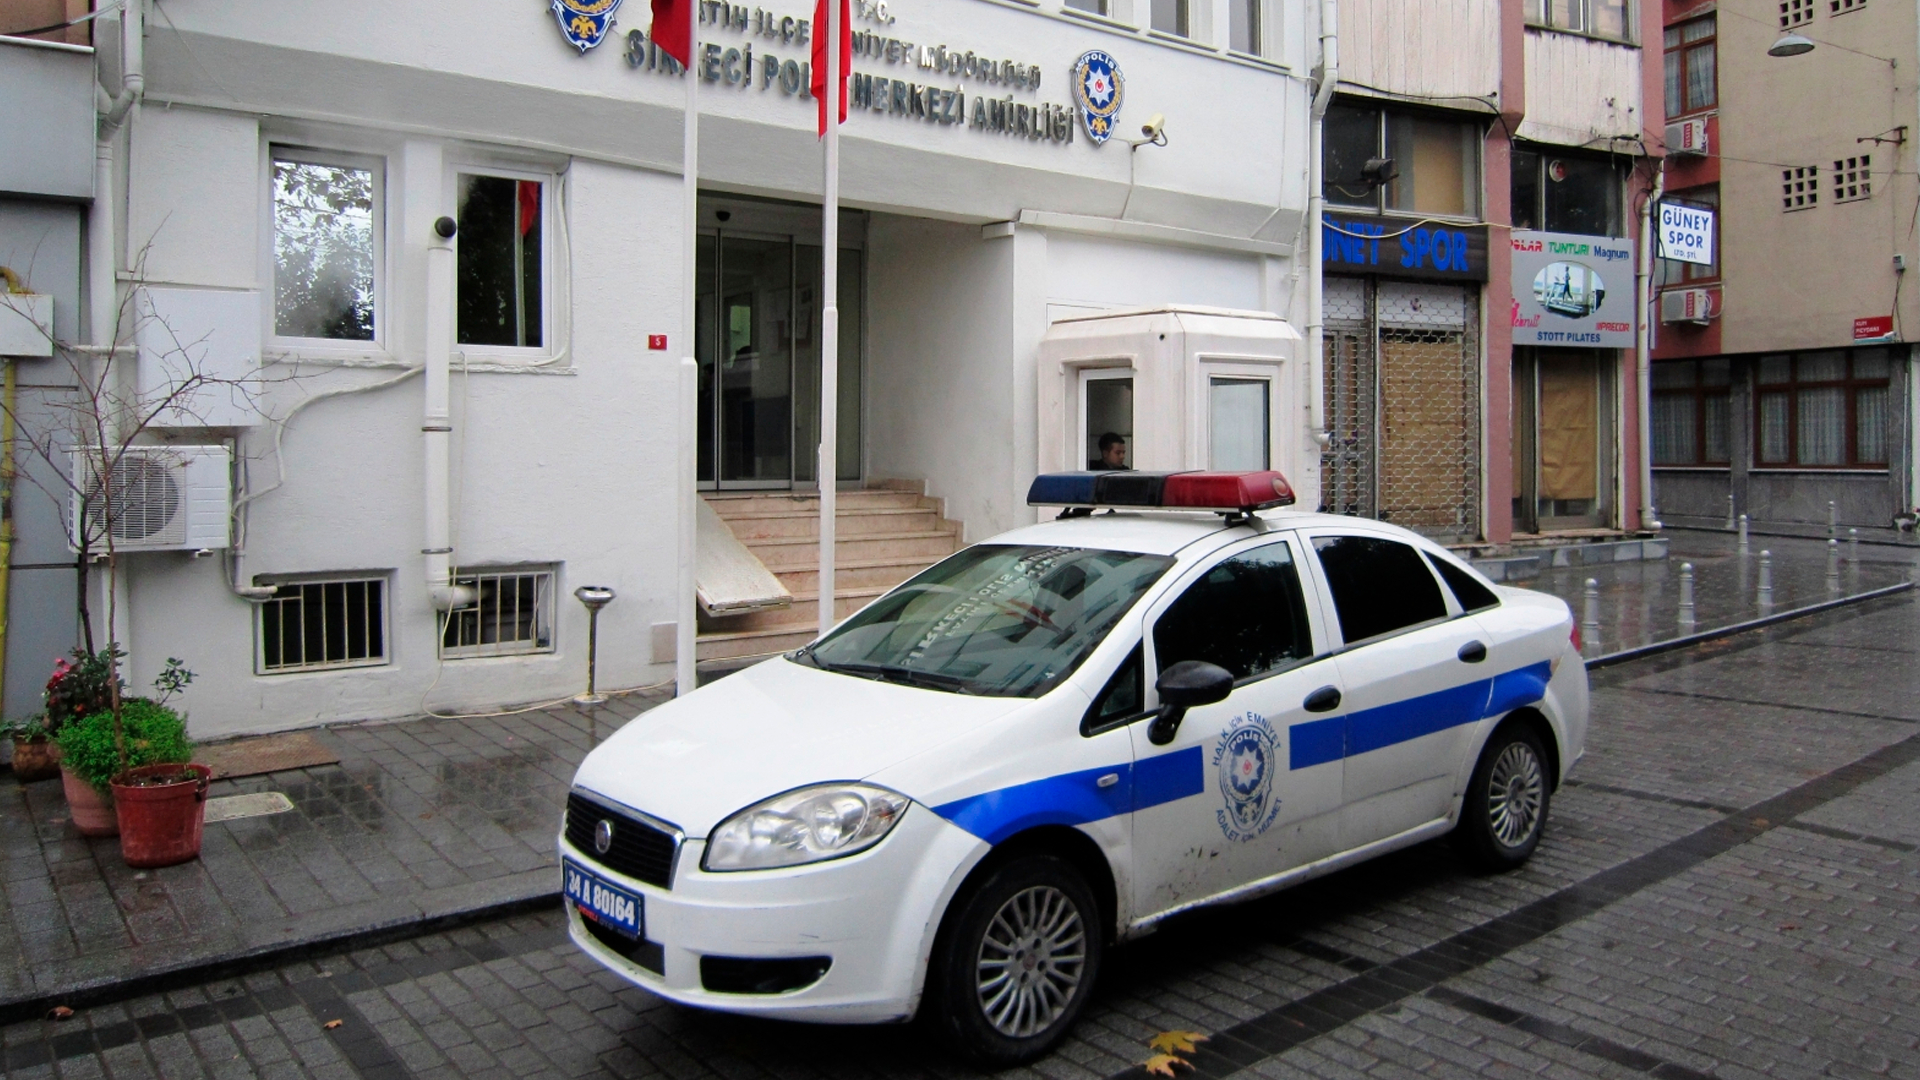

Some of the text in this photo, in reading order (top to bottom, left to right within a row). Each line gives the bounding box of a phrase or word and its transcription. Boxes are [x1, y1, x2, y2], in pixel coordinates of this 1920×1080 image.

[1085, 53, 1115, 70] POLİS
[849, 71, 965, 126] MERKEZİ
[970, 93, 1074, 145] AMİRLİĞİ
[1662, 207, 1710, 231] GÜNEY
[1322, 213, 1469, 272] ÜNEY SPOR
[1669, 230, 1703, 249] SPOR
[1594, 245, 1630, 261] Magnum
[1537, 331, 1601, 344] STOTT PILATES
[1212, 729, 1230, 767] HALK
[1246, 710, 1282, 750] EMNİYET
[1229, 729, 1261, 752] POLİS
[1216, 808, 1240, 843] ADALET
[568, 869, 581, 899] 34
[582, 879, 591, 906] A
[593, 884, 636, 927] 80164
